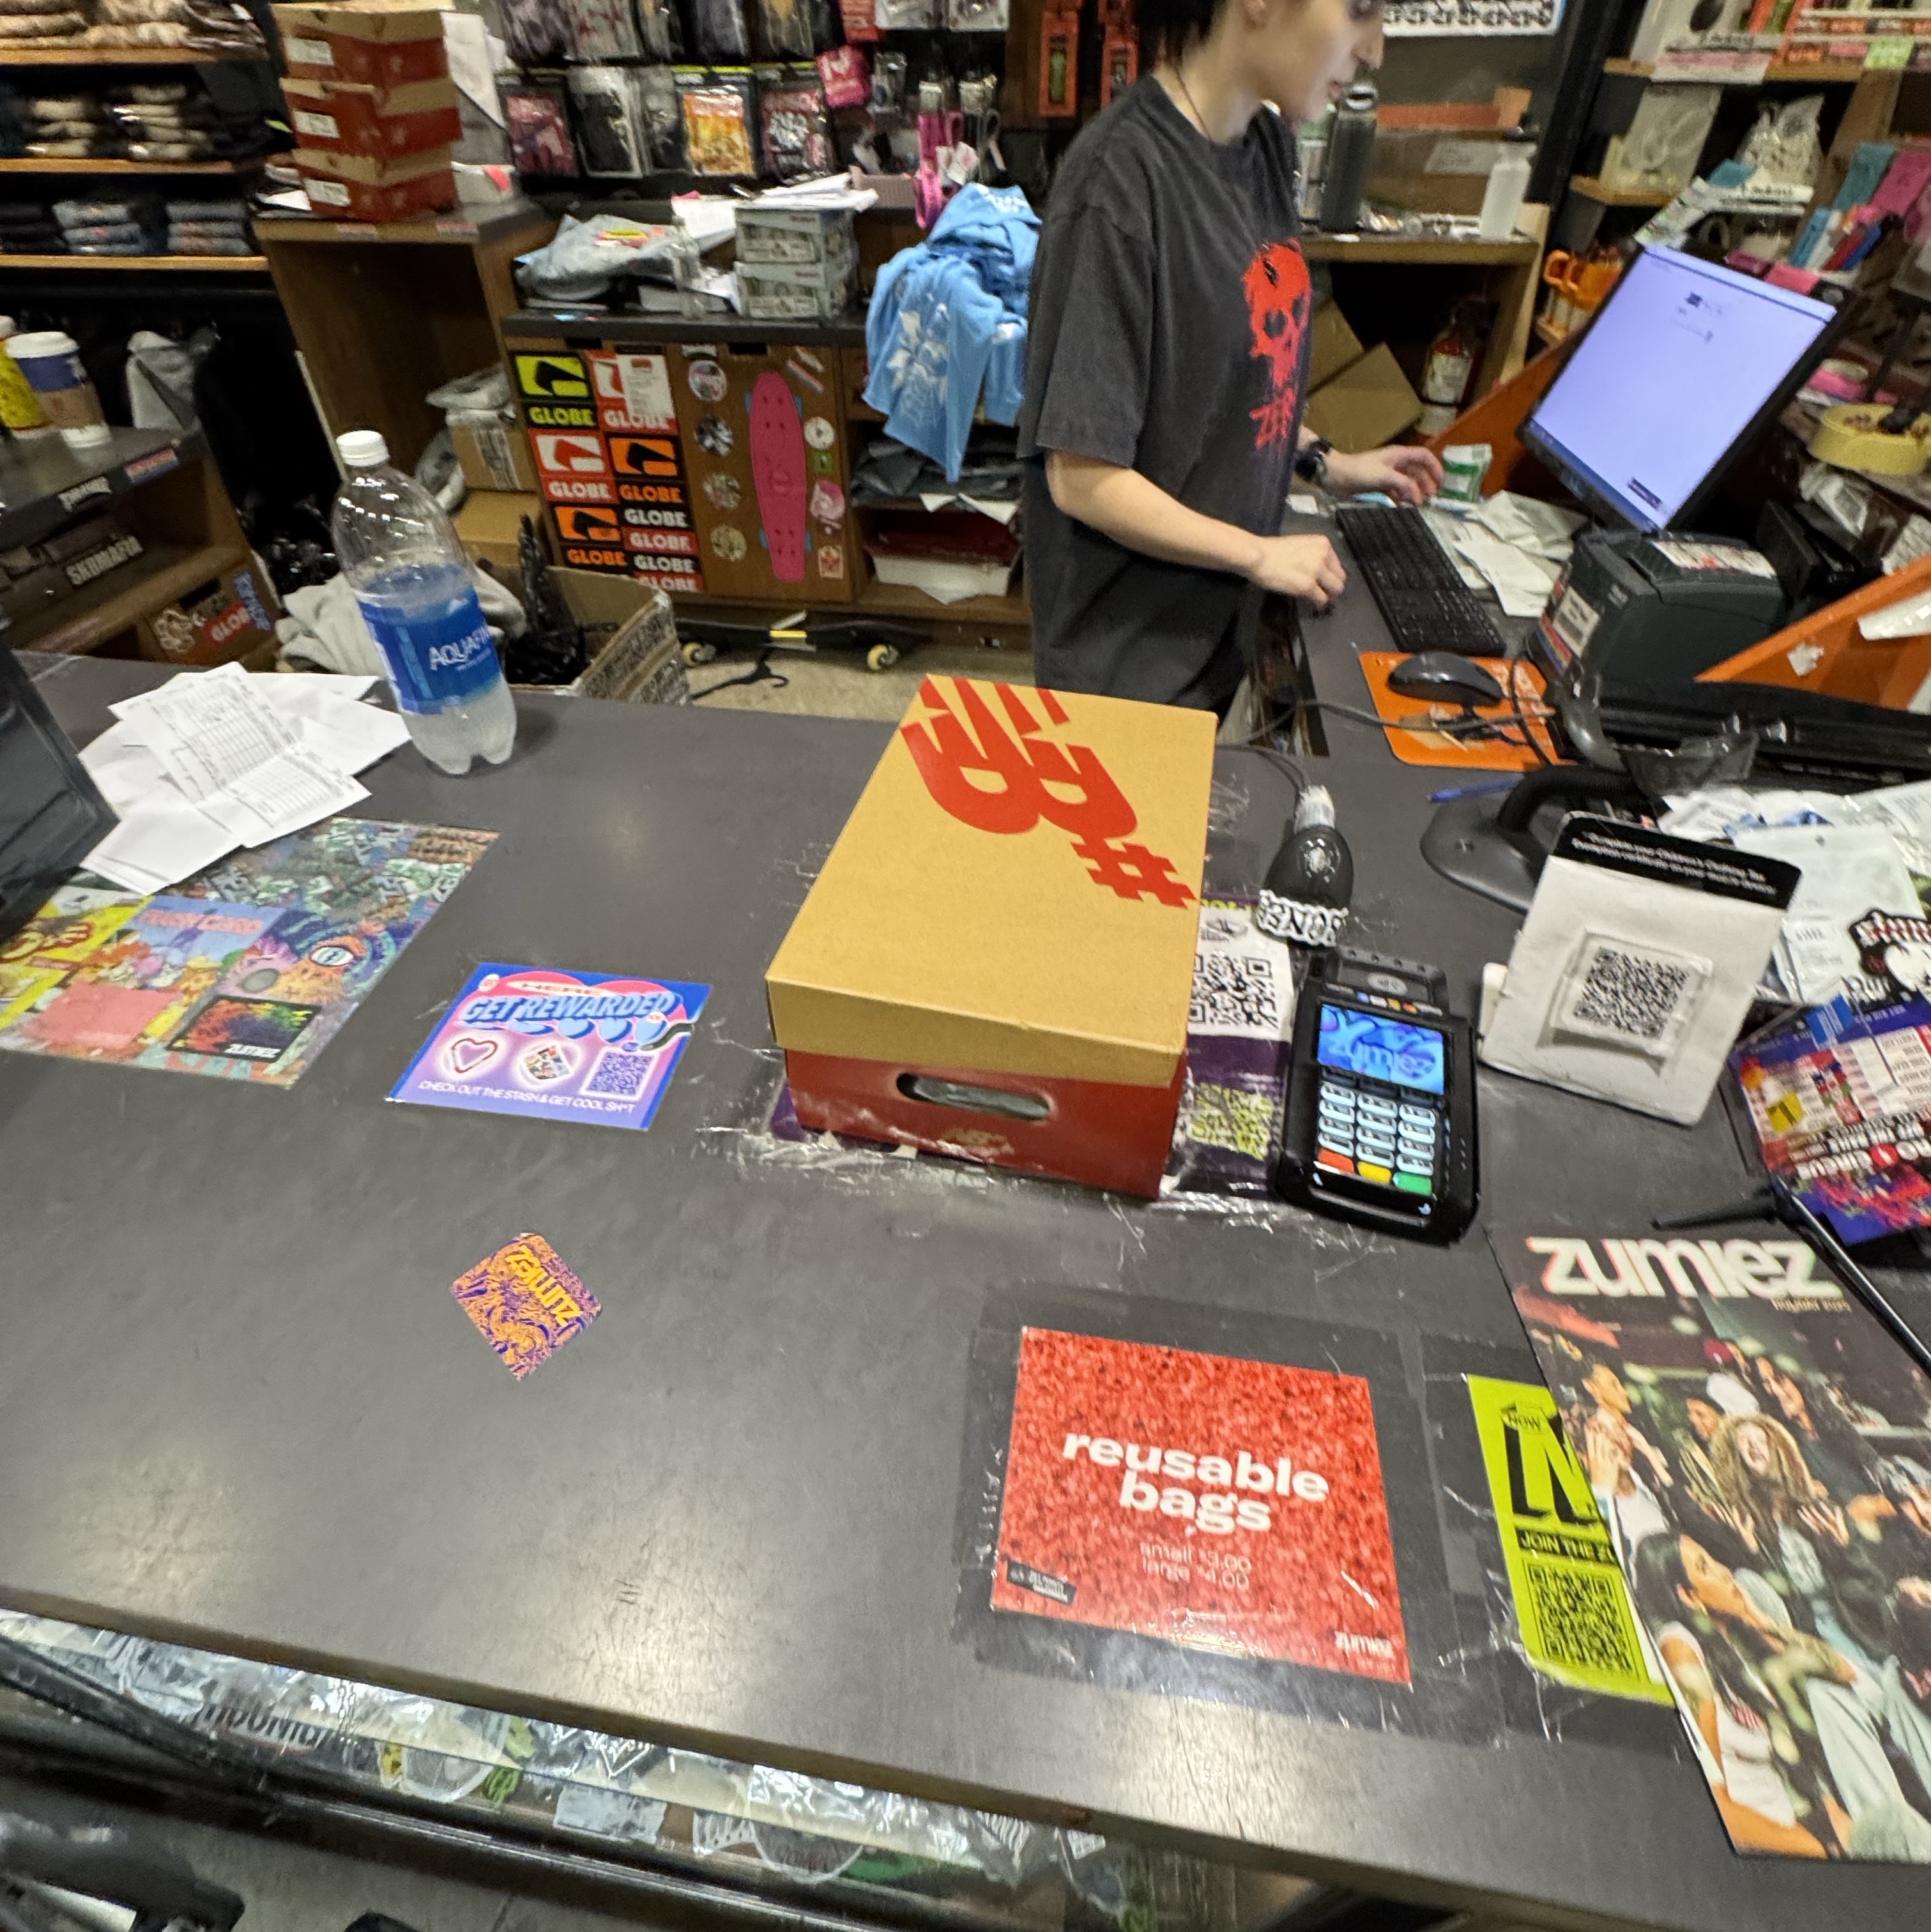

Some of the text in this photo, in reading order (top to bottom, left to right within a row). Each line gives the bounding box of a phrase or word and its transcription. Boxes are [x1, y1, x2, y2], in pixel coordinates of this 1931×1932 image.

[528, 406, 597, 427] GLOBE
[548, 481, 611, 499] GLOBE
[619, 484, 683, 503] GLOBE
[624, 508, 688, 528] GLOBE
[629, 532, 691, 551] GLOBE
[567, 549, 627, 566] GLOBE
[634, 554, 694, 573] GLOBE
[462, 991, 680, 1022] GET REWARDED
[418, 1080, 455, 1093] CHECK
[457, 1084, 479, 1096] OUT
[482, 1087, 505, 1099] THE
[548, 1095, 571, 1107] GET
[572, 1097, 604, 1111] COOL
[1062, 1432, 1329, 1502] reusable
[1119, 1470, 1272, 1537] bags
[1520, 1530, 1560, 1555] JOIN
